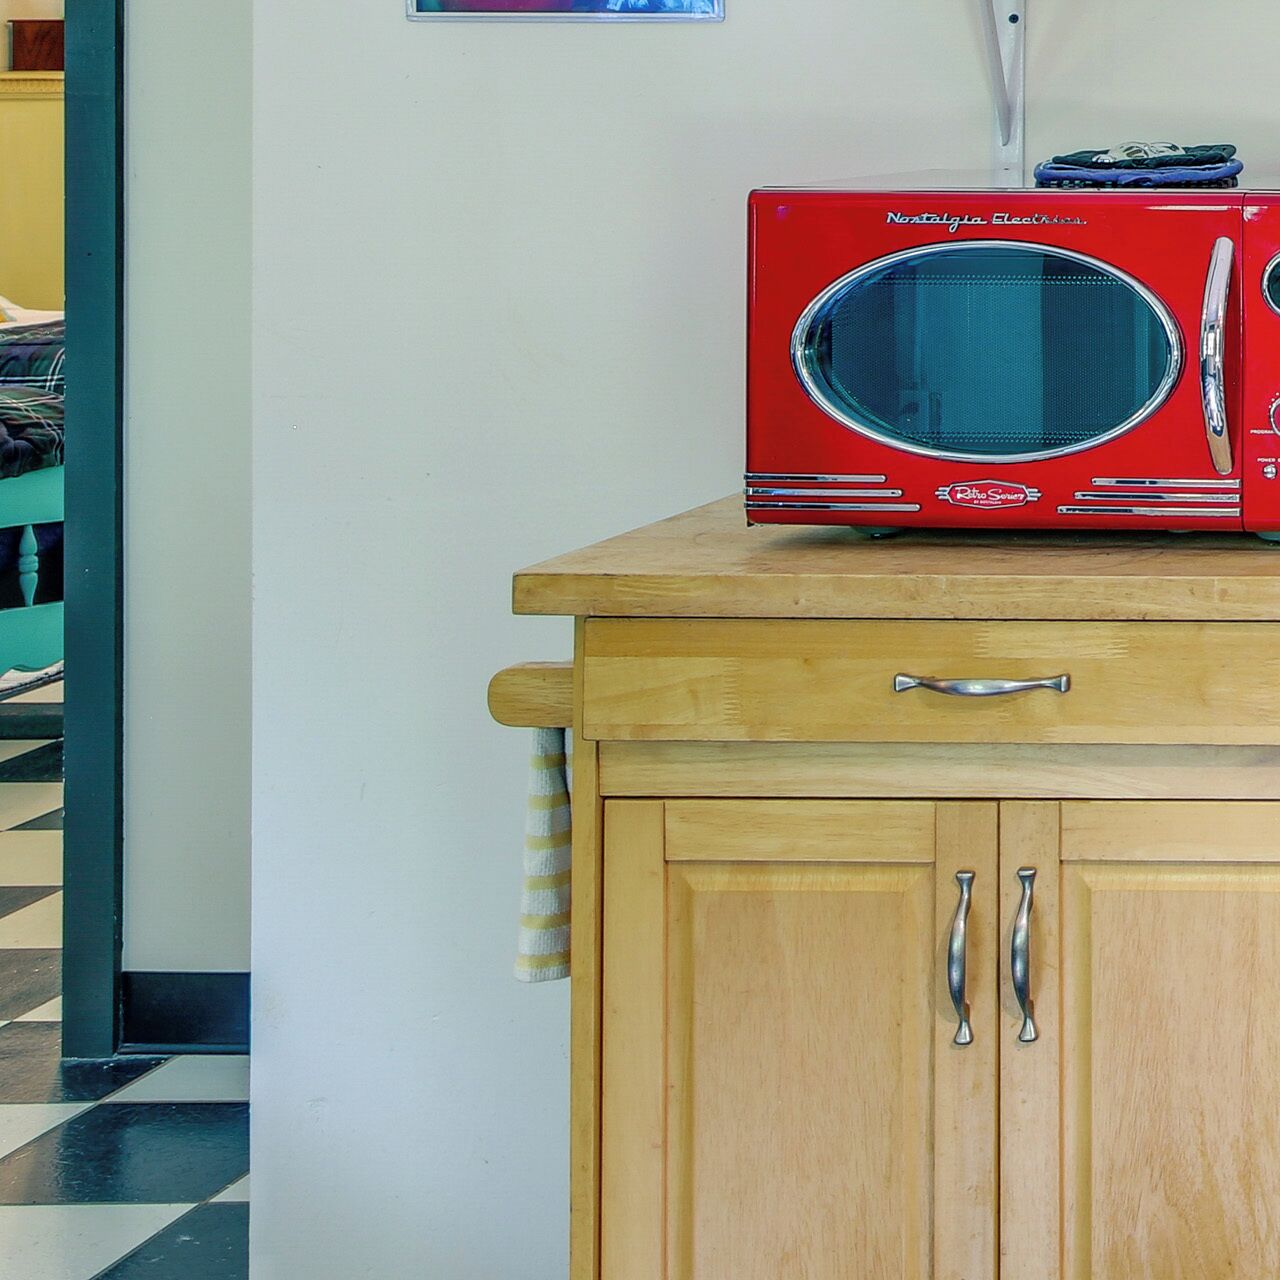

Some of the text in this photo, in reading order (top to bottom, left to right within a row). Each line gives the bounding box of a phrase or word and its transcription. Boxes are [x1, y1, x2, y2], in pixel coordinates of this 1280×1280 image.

[886, 212, 988, 233] Nostalgia
[954, 486, 1025, 501] Retro Series
